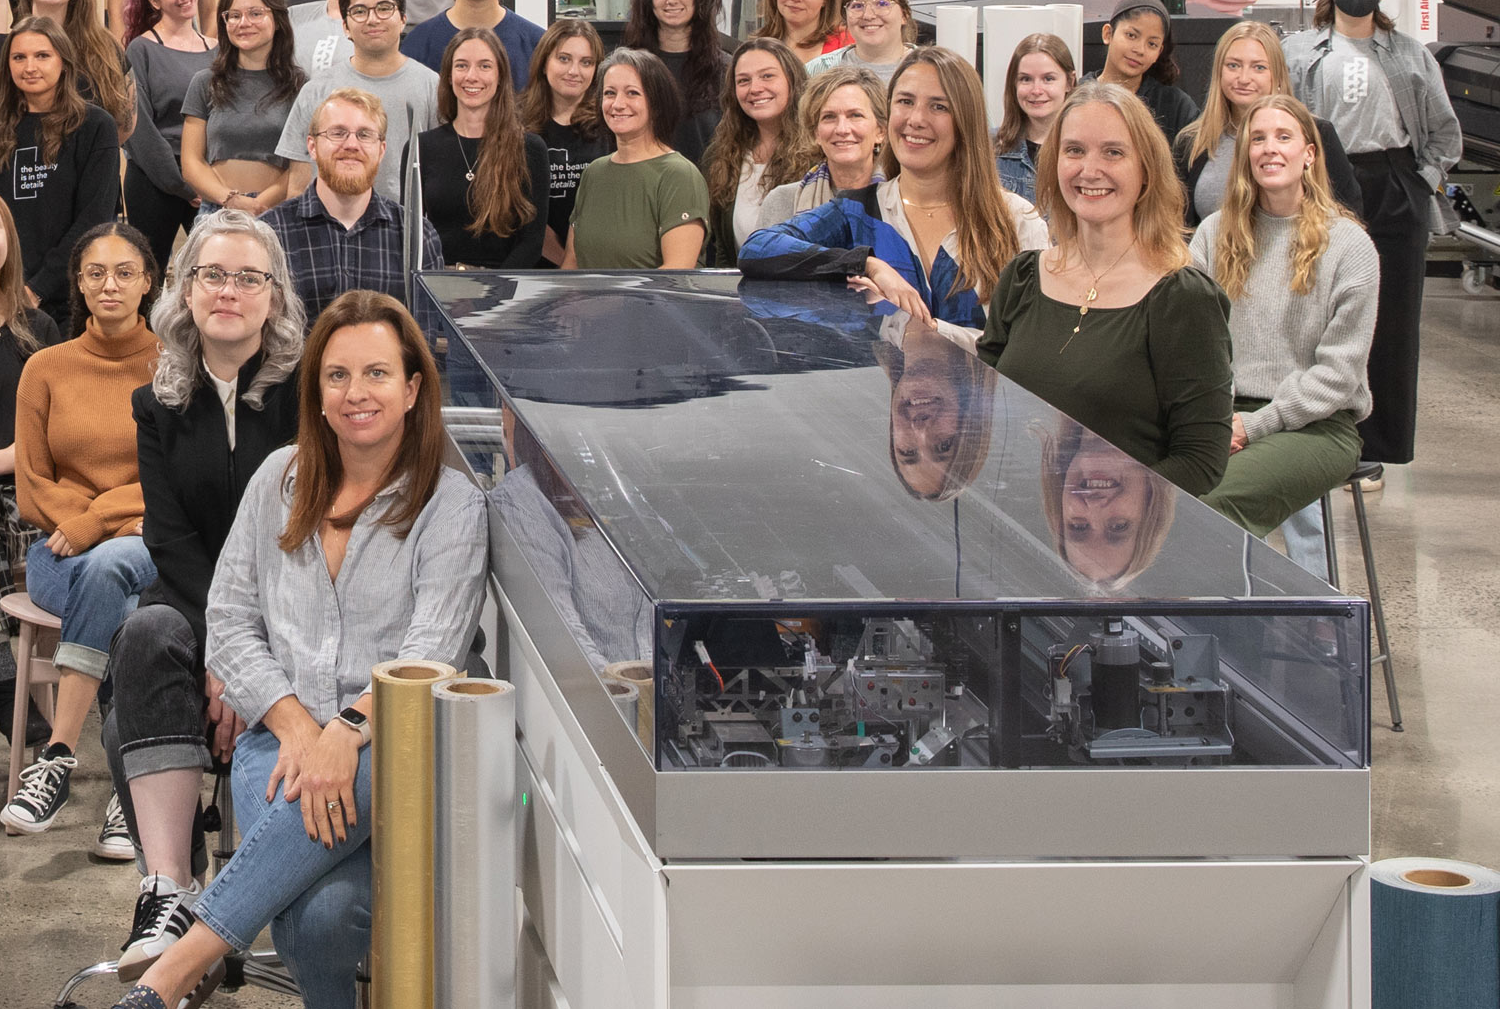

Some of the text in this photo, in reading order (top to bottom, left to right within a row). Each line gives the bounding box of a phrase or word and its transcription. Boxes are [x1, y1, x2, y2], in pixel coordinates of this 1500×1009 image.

[1420, 11, 1429, 30] First
[21, 165, 33, 173] the
[550, 162, 590, 171] the beaut
[550, 172, 557, 180] is
[567, 171, 580, 179] the
[21, 180, 44, 189] details
[550, 180, 576, 189] details
